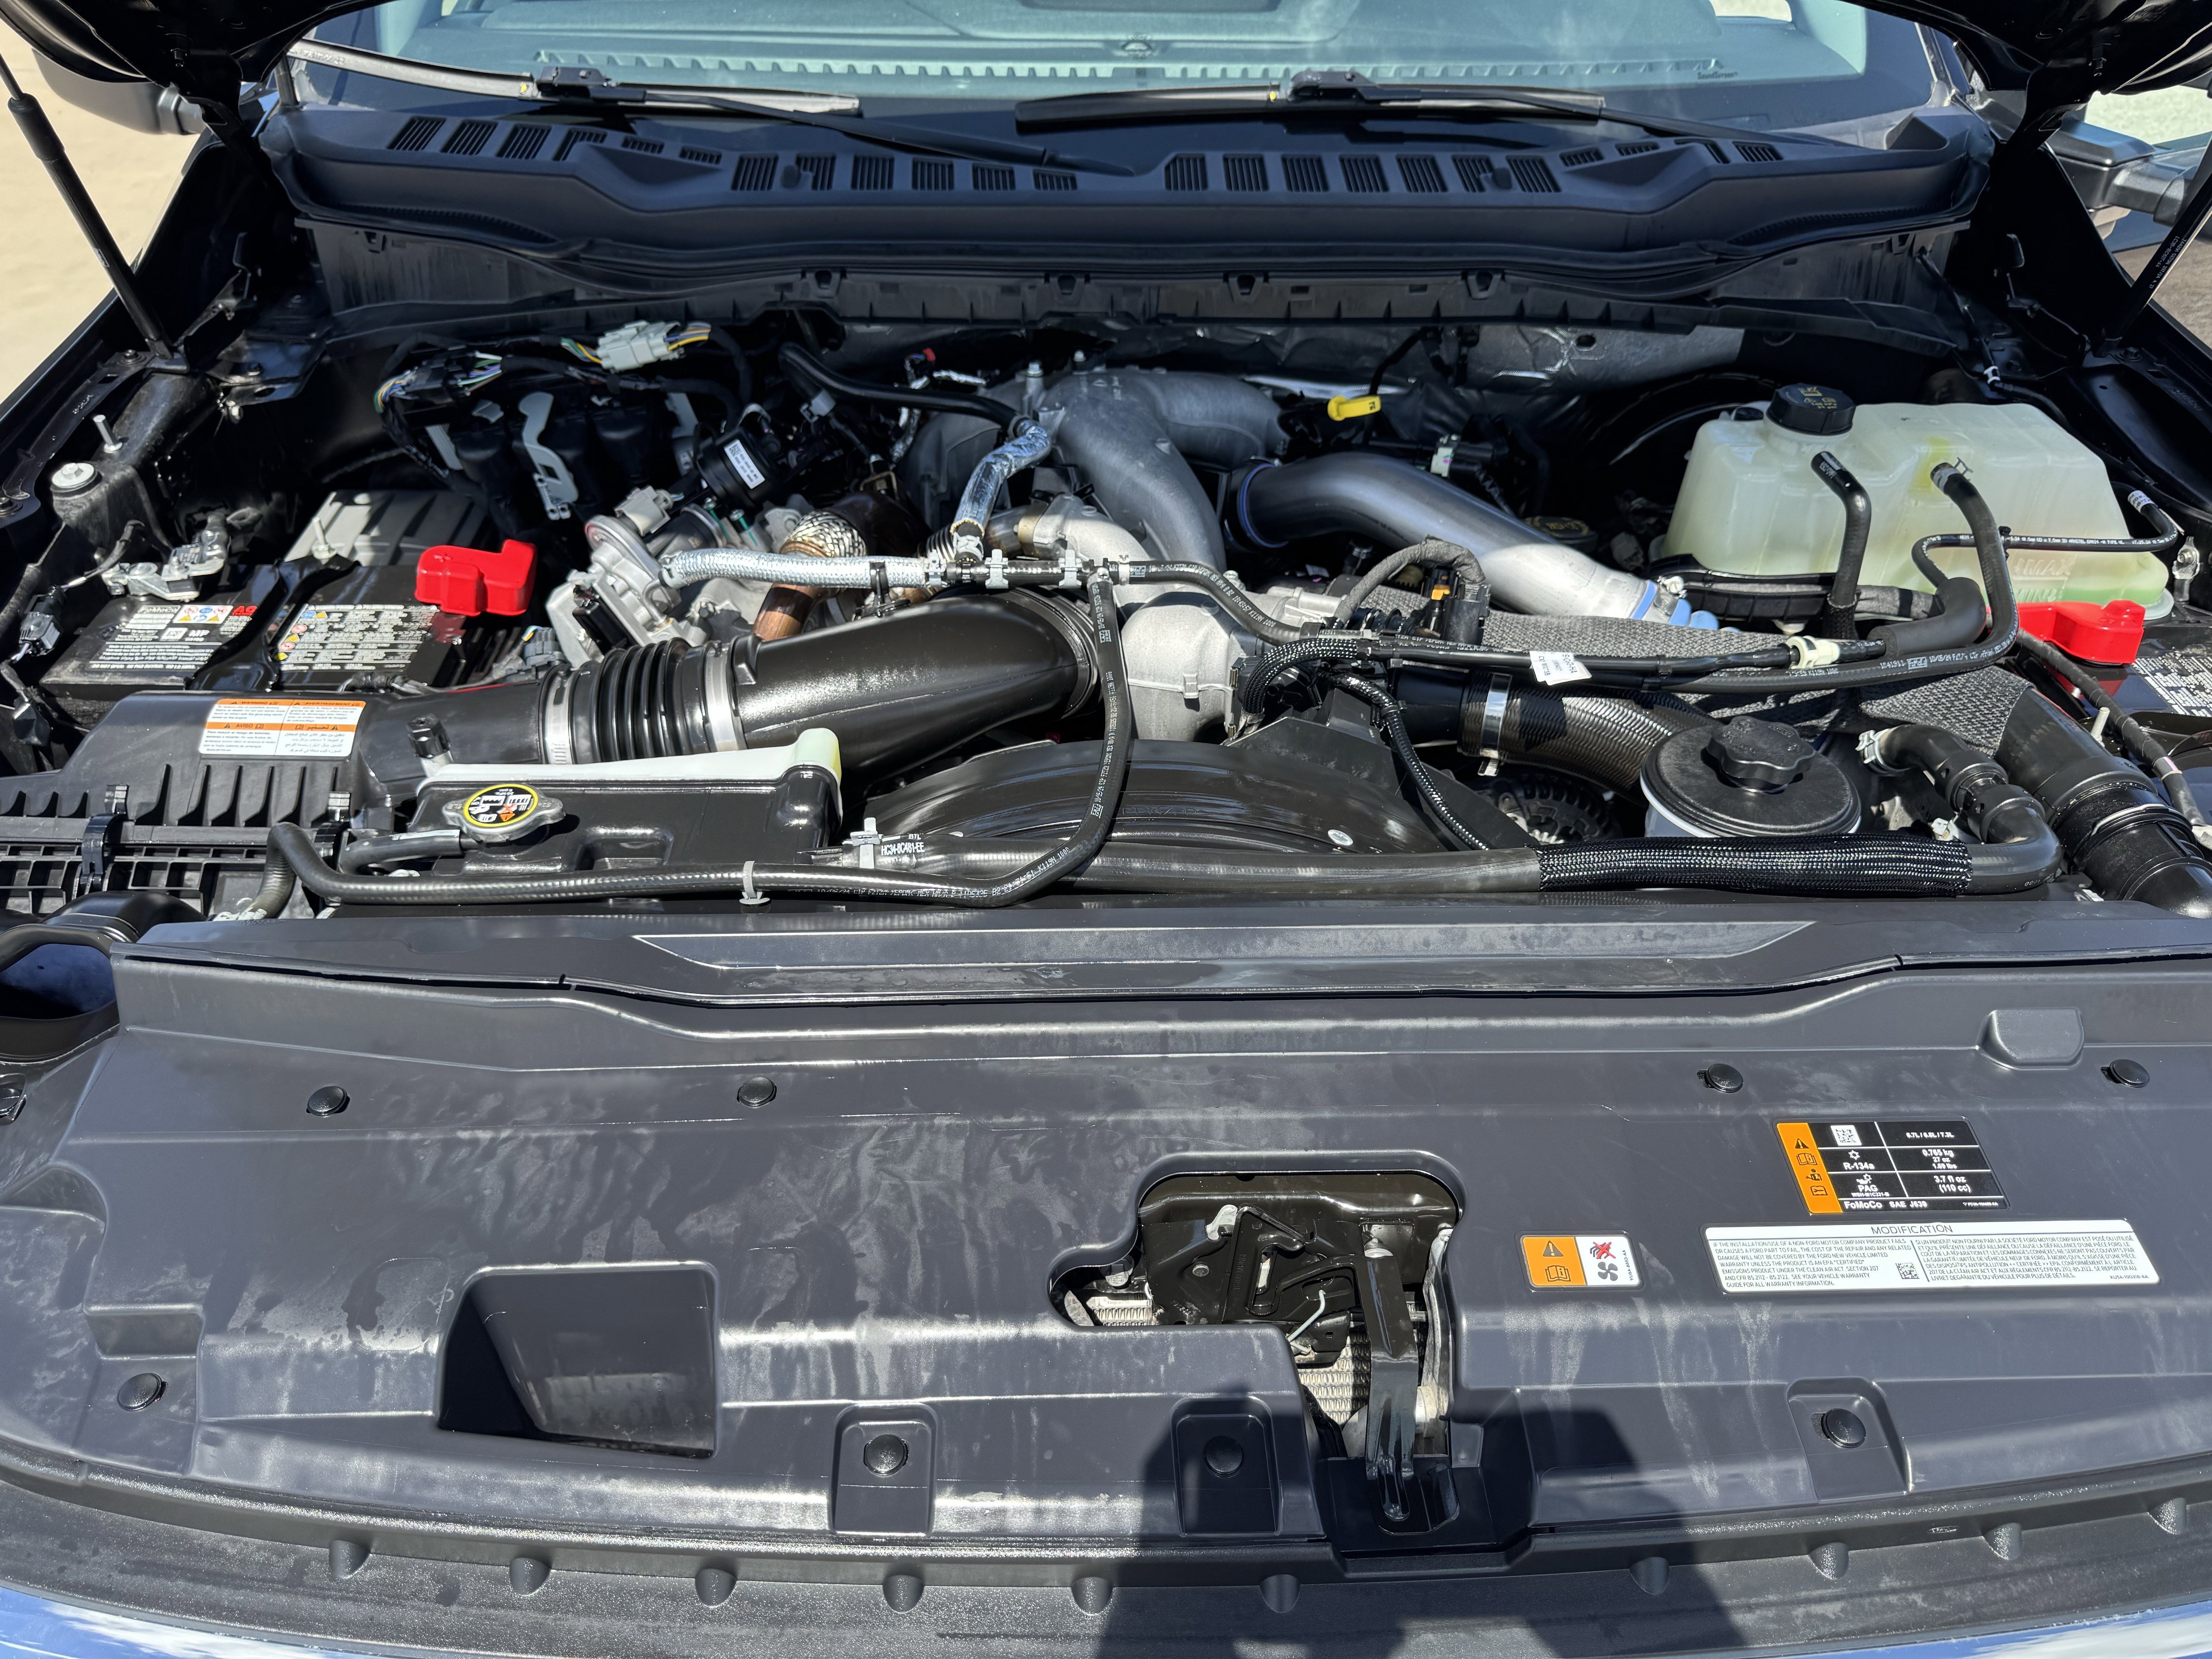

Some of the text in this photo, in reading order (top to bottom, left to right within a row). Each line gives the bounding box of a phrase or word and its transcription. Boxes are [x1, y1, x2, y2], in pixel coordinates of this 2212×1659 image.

[1942, 1149, 1954, 1158] kg
[1934, 1175, 1945, 1183] 3.7
[1939, 1183, 1971, 1194] (110 cc)
[1844, 1201, 1882, 1209] FoMoCo
[1870, 1224, 1953, 1234] MODIFICATION
